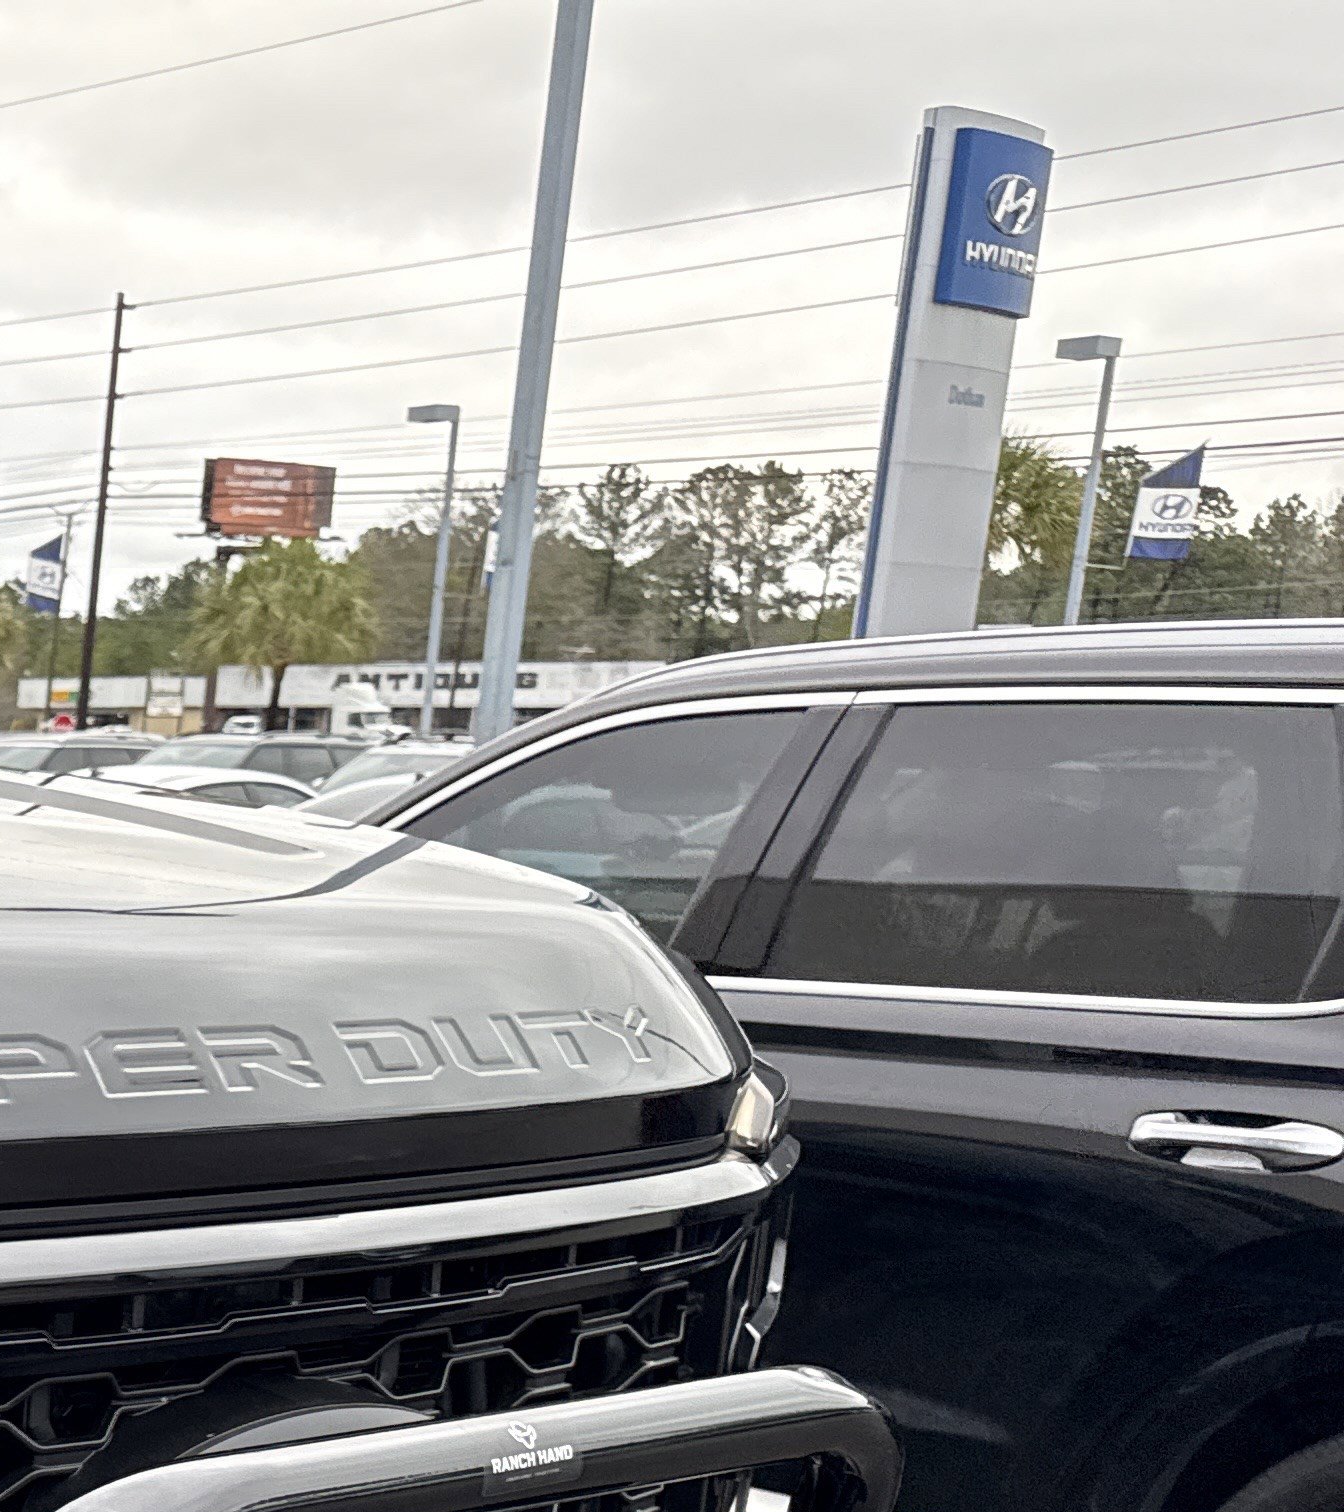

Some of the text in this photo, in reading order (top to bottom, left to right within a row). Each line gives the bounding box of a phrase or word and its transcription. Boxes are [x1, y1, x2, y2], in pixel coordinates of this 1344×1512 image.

[332, 1004, 653, 1086] DUTY
[490, 1443, 574, 1474] RANCH HAND
